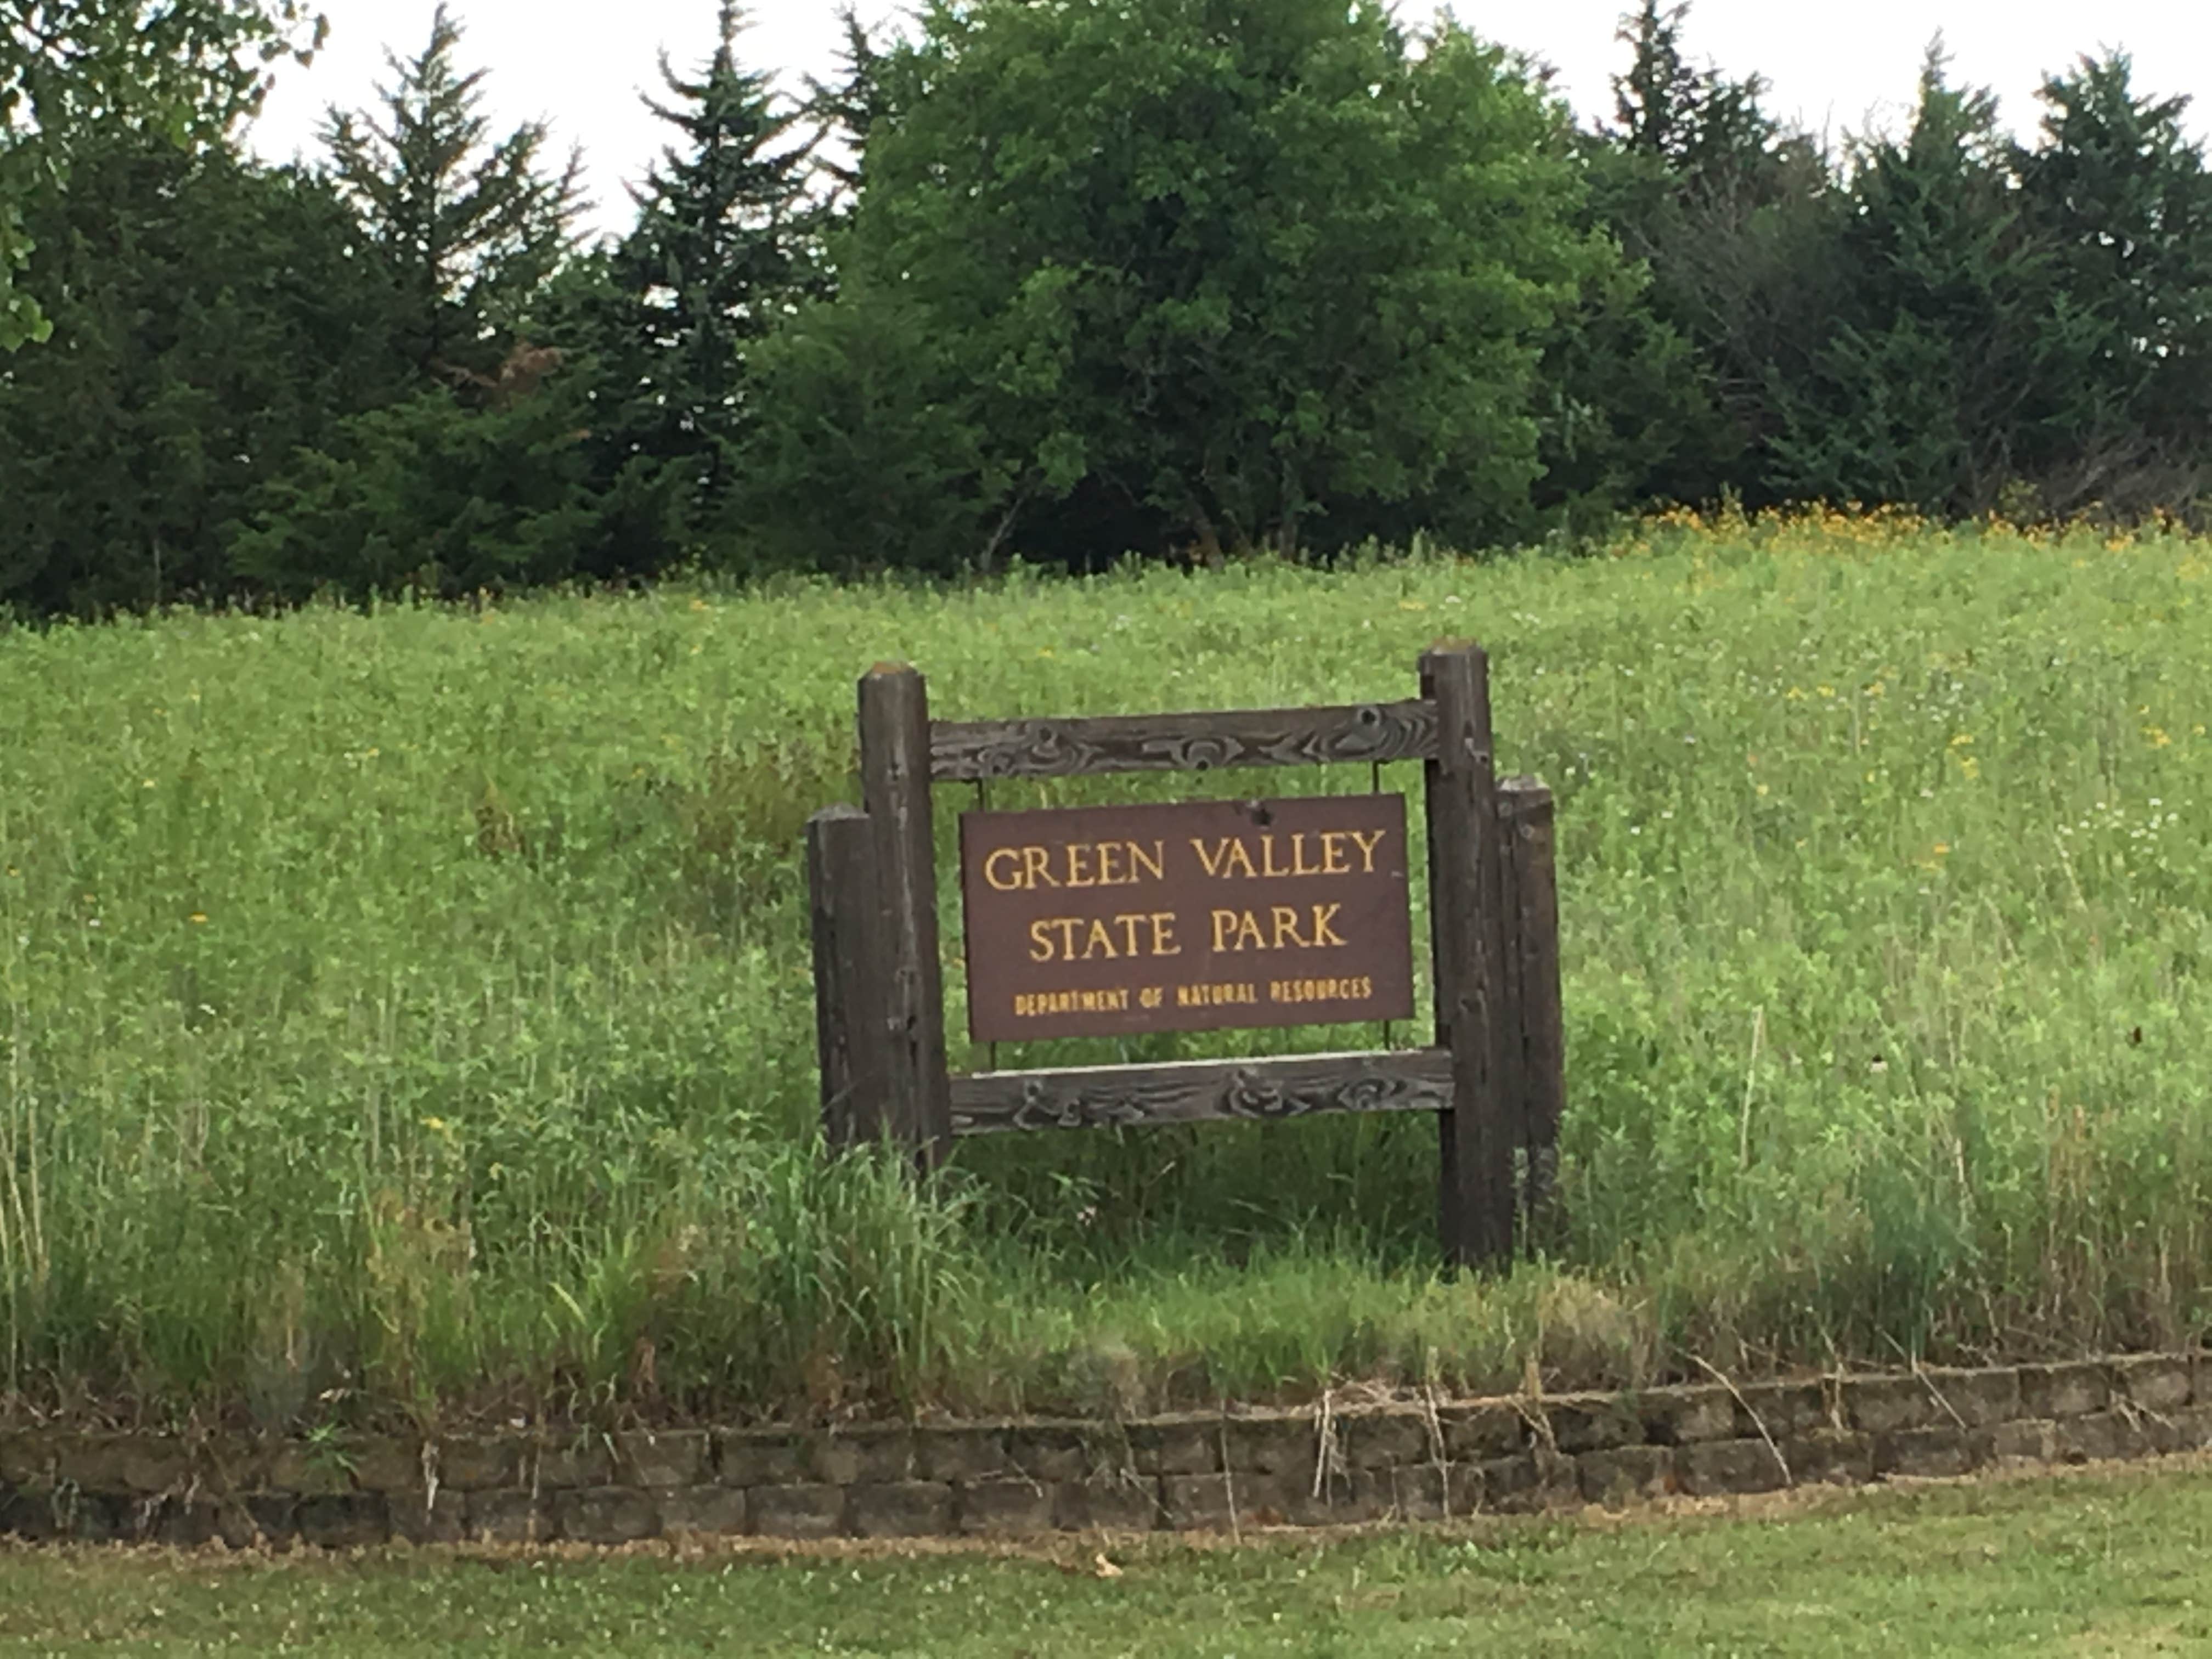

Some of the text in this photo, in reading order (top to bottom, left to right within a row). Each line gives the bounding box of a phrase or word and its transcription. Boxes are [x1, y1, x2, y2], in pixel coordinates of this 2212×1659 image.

[984, 831, 1385, 890] GREEN VALLEY
[1029, 903, 1348, 961] STATE PARK
[1014, 976, 1372, 1016] DEPARTMENT OF NATURAL RESOURCES
